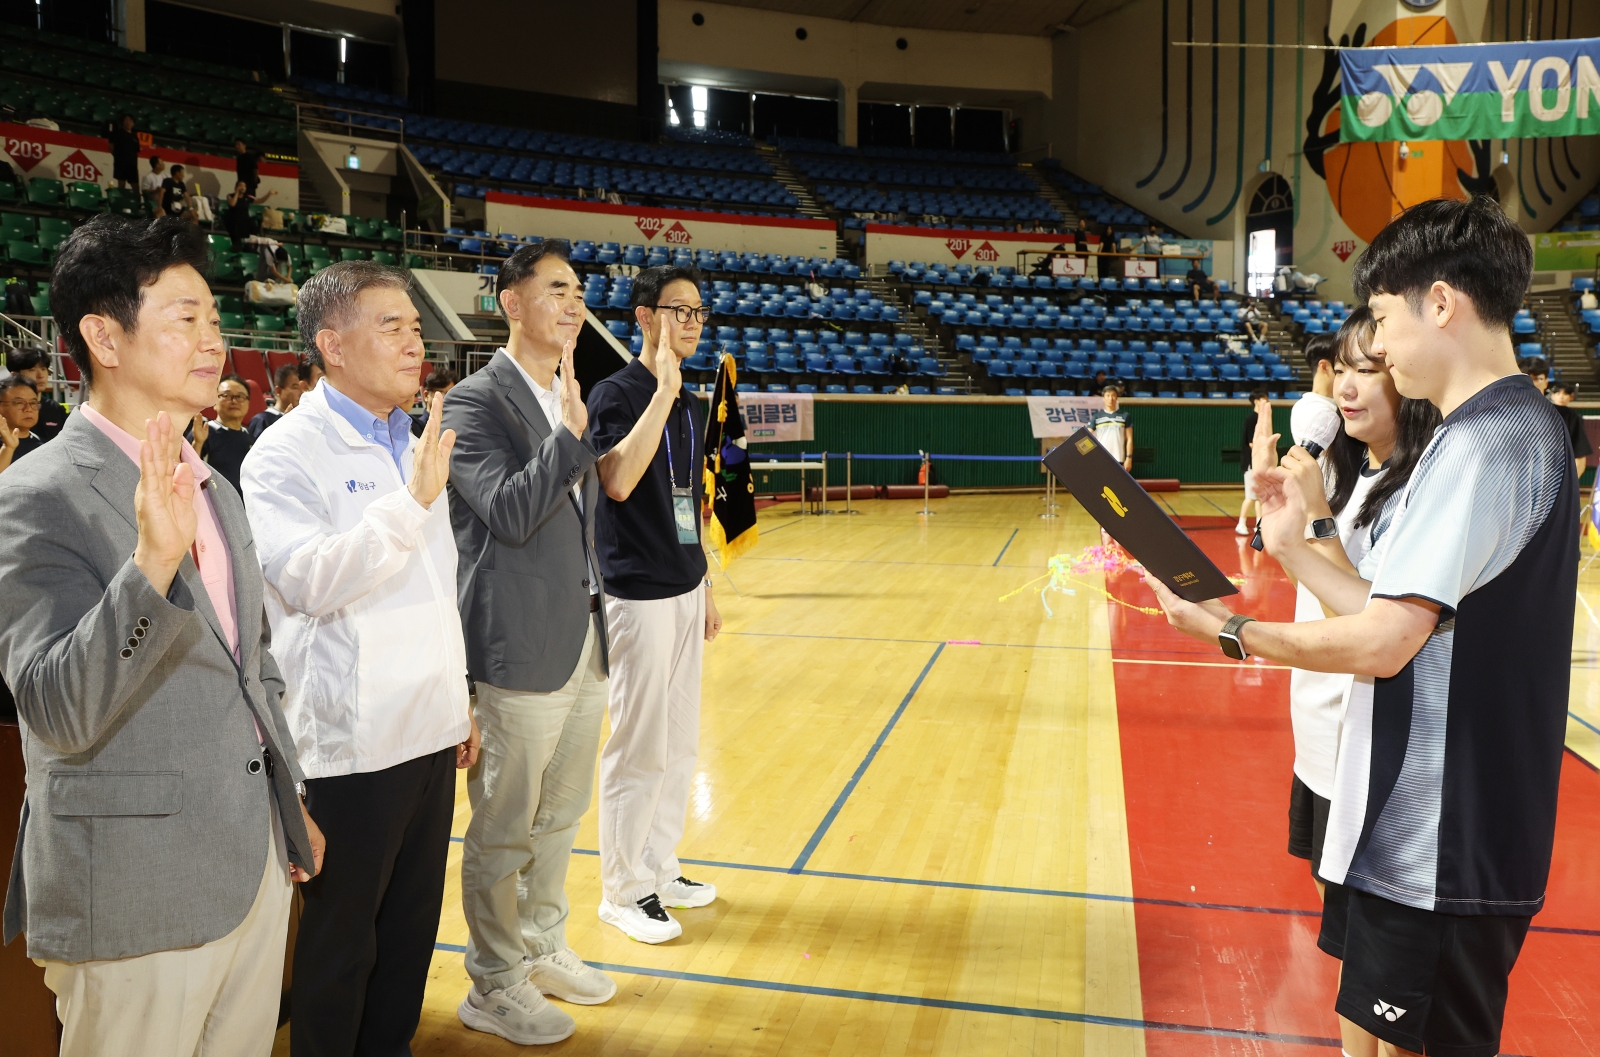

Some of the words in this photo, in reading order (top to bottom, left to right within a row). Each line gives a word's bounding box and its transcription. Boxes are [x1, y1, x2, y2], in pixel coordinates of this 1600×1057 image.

[8, 139, 43, 160] 203
[349, 144, 357, 155] 2
[63, 161, 95, 181] 303
[640, 217, 661, 231] 202
[668, 230, 688, 243] 302
[950, 239, 967, 251] 201
[1335, 240, 1354, 255] 218
[977, 249, 995, 261] 301
[479, 275, 496, 294] 가
[739, 403, 797, 424] 림클럽
[357, 481, 376, 491] 강남구
